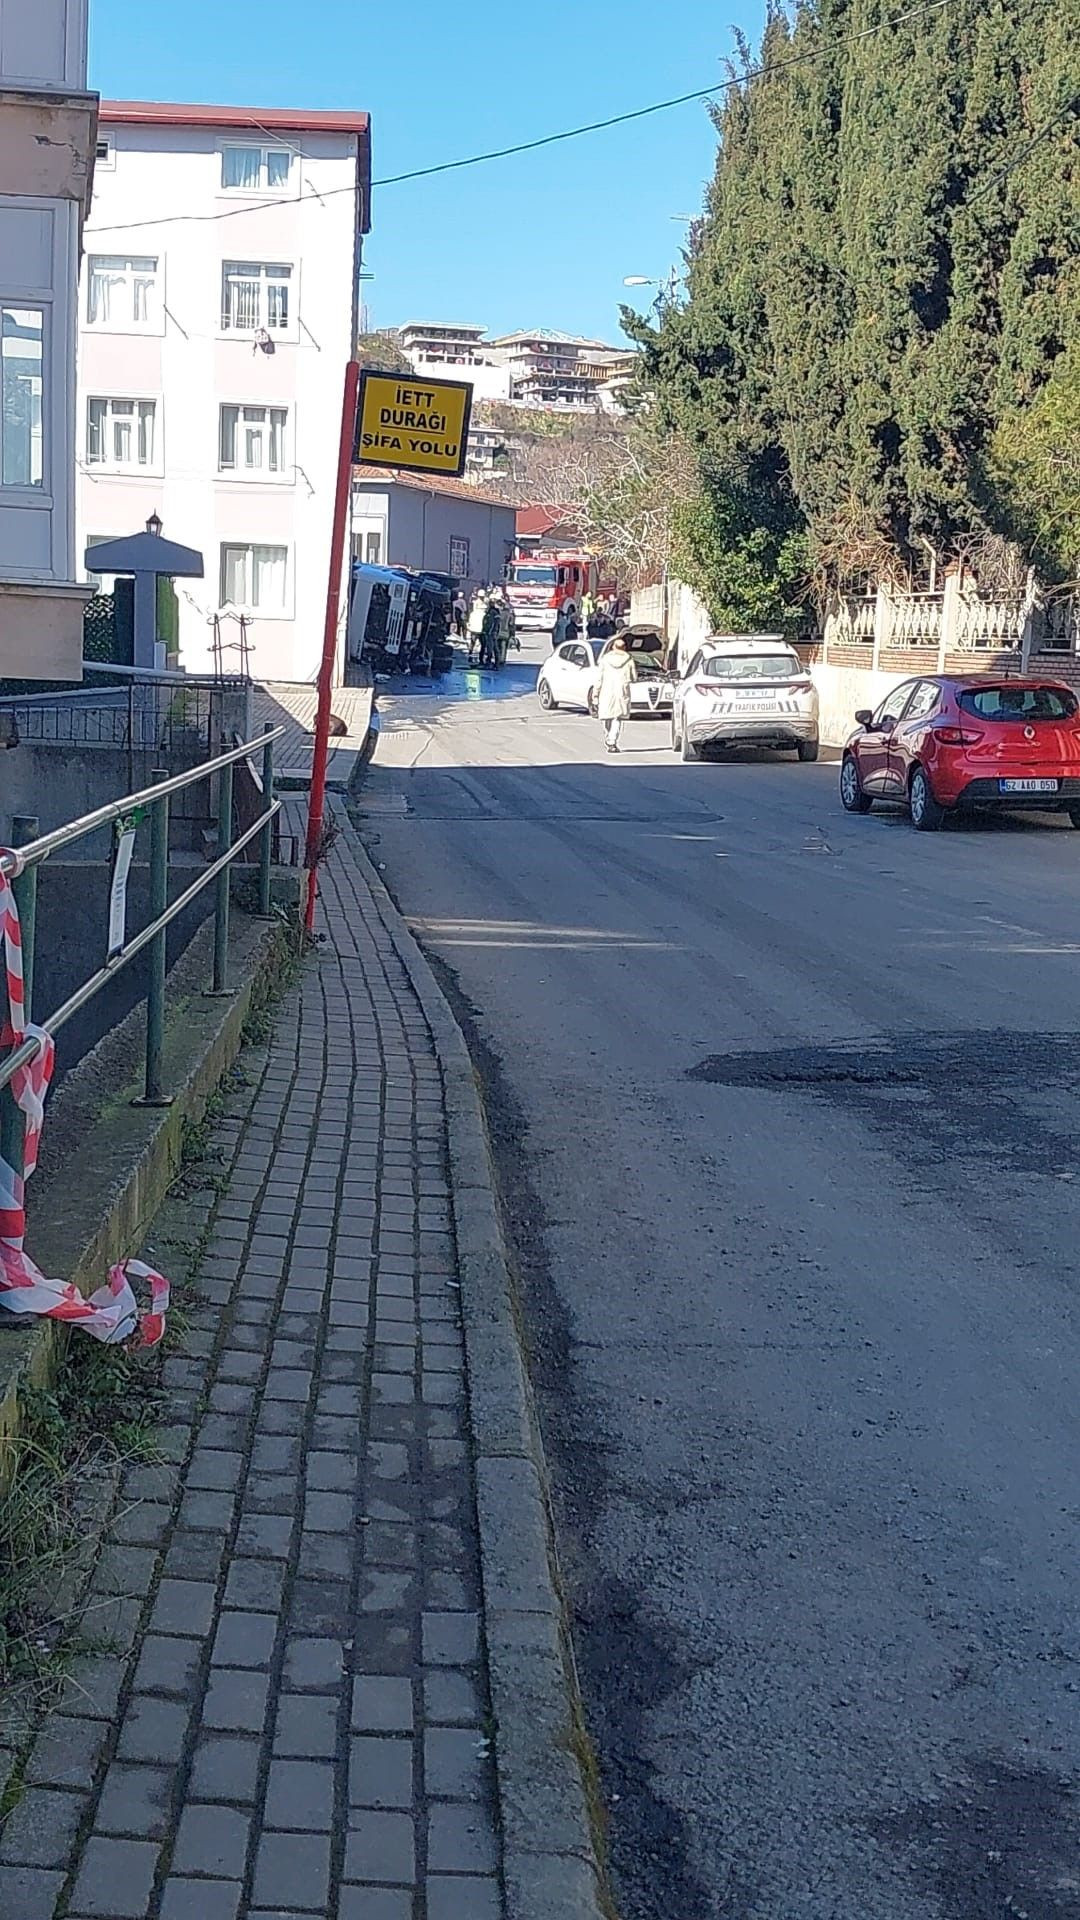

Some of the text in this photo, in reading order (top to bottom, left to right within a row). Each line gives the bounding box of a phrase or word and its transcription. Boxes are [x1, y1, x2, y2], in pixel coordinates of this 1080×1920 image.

[396, 385, 435, 407] İETT
[380, 408, 446, 431] DURAĞI
[362, 432, 457, 457] ŞİFA YOLU
